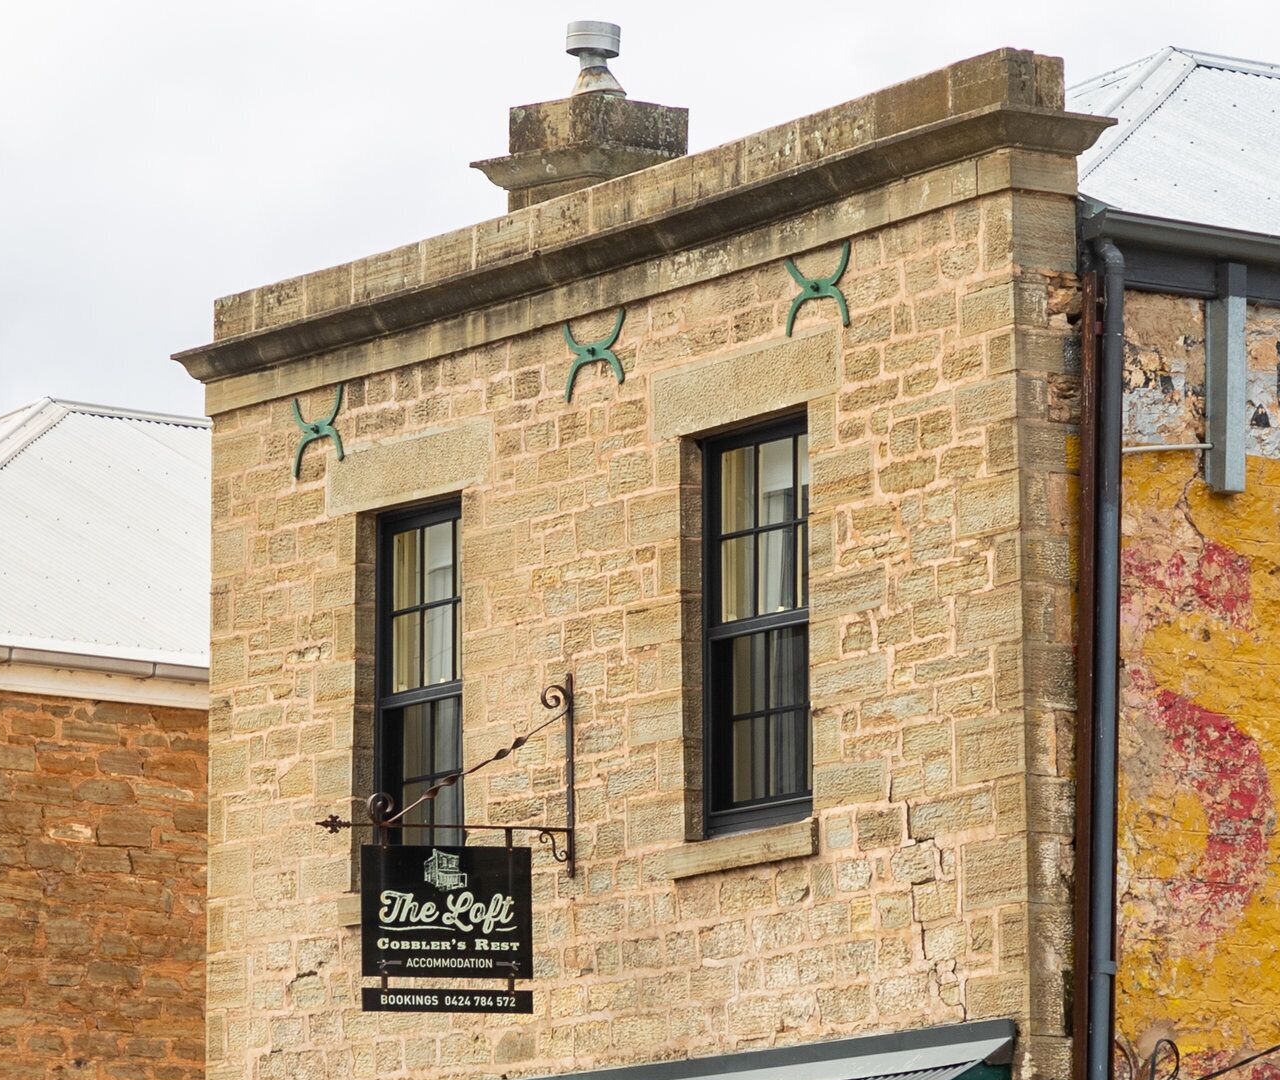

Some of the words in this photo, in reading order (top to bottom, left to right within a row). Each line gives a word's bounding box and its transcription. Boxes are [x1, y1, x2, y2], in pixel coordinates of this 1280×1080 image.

[378, 889, 440, 925] The
[442, 890, 516, 933] Loft
[406, 957, 493, 970] ACCOMMODATION
[380, 994, 439, 1006] BOOKINGS
[445, 995, 471, 1007] 0424
[473, 995, 494, 1007] 784
[496, 995, 516, 1007] 572
